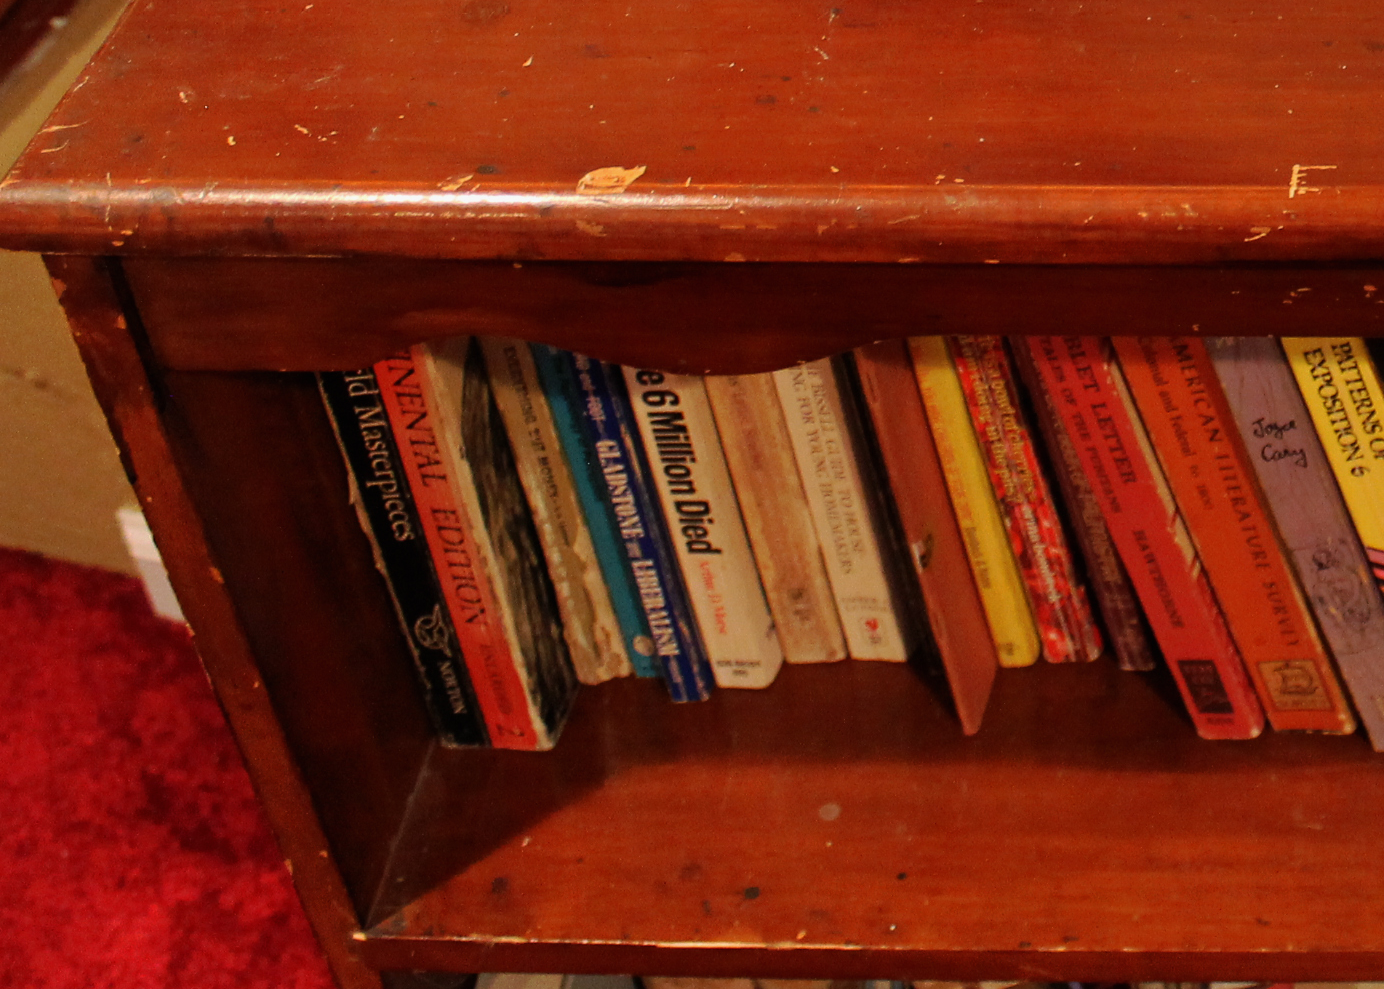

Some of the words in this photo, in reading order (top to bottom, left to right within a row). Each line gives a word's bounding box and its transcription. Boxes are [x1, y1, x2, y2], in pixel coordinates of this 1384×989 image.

[643, 391, 680, 407] 6
[798, 396, 815, 425] FOR
[1159, 391, 1179, 413] and
[1169, 415, 1197, 457] Federal
[1252, 417, 1297, 439] Joyce
[1303, 347, 1364, 463] EXPOSITION
[1350, 465, 1371, 478] 6
[1331, 341, 1382, 436] PATTERNS
[354, 401, 417, 542] Masterpieces
[648, 410, 697, 495] Million
[806, 430, 827, 478] YOUNG
[1062, 388, 1078, 407] OF
[1071, 413, 1091, 441] THE
[1085, 446, 1121, 513] PURITANS
[1090, 402, 1138, 484] LETTER
[1261, 444, 1308, 468] Cary
[675, 500, 722, 555] Died
[820, 482, 851, 575] HOMEMAKERS
[1171, 343, 1222, 443] MERICAN
[1213, 452, 1271, 569] LITERATURE
[1263, 581, 1301, 647] SURVEY
[430, 506, 486, 623] EDITION
[595, 439, 646, 540] GLADSTONE
[631, 558, 681, 656] LIBERALISM
[1132, 529, 1184, 629] HAWTHORNE
[439, 659, 468, 715] NORTON
